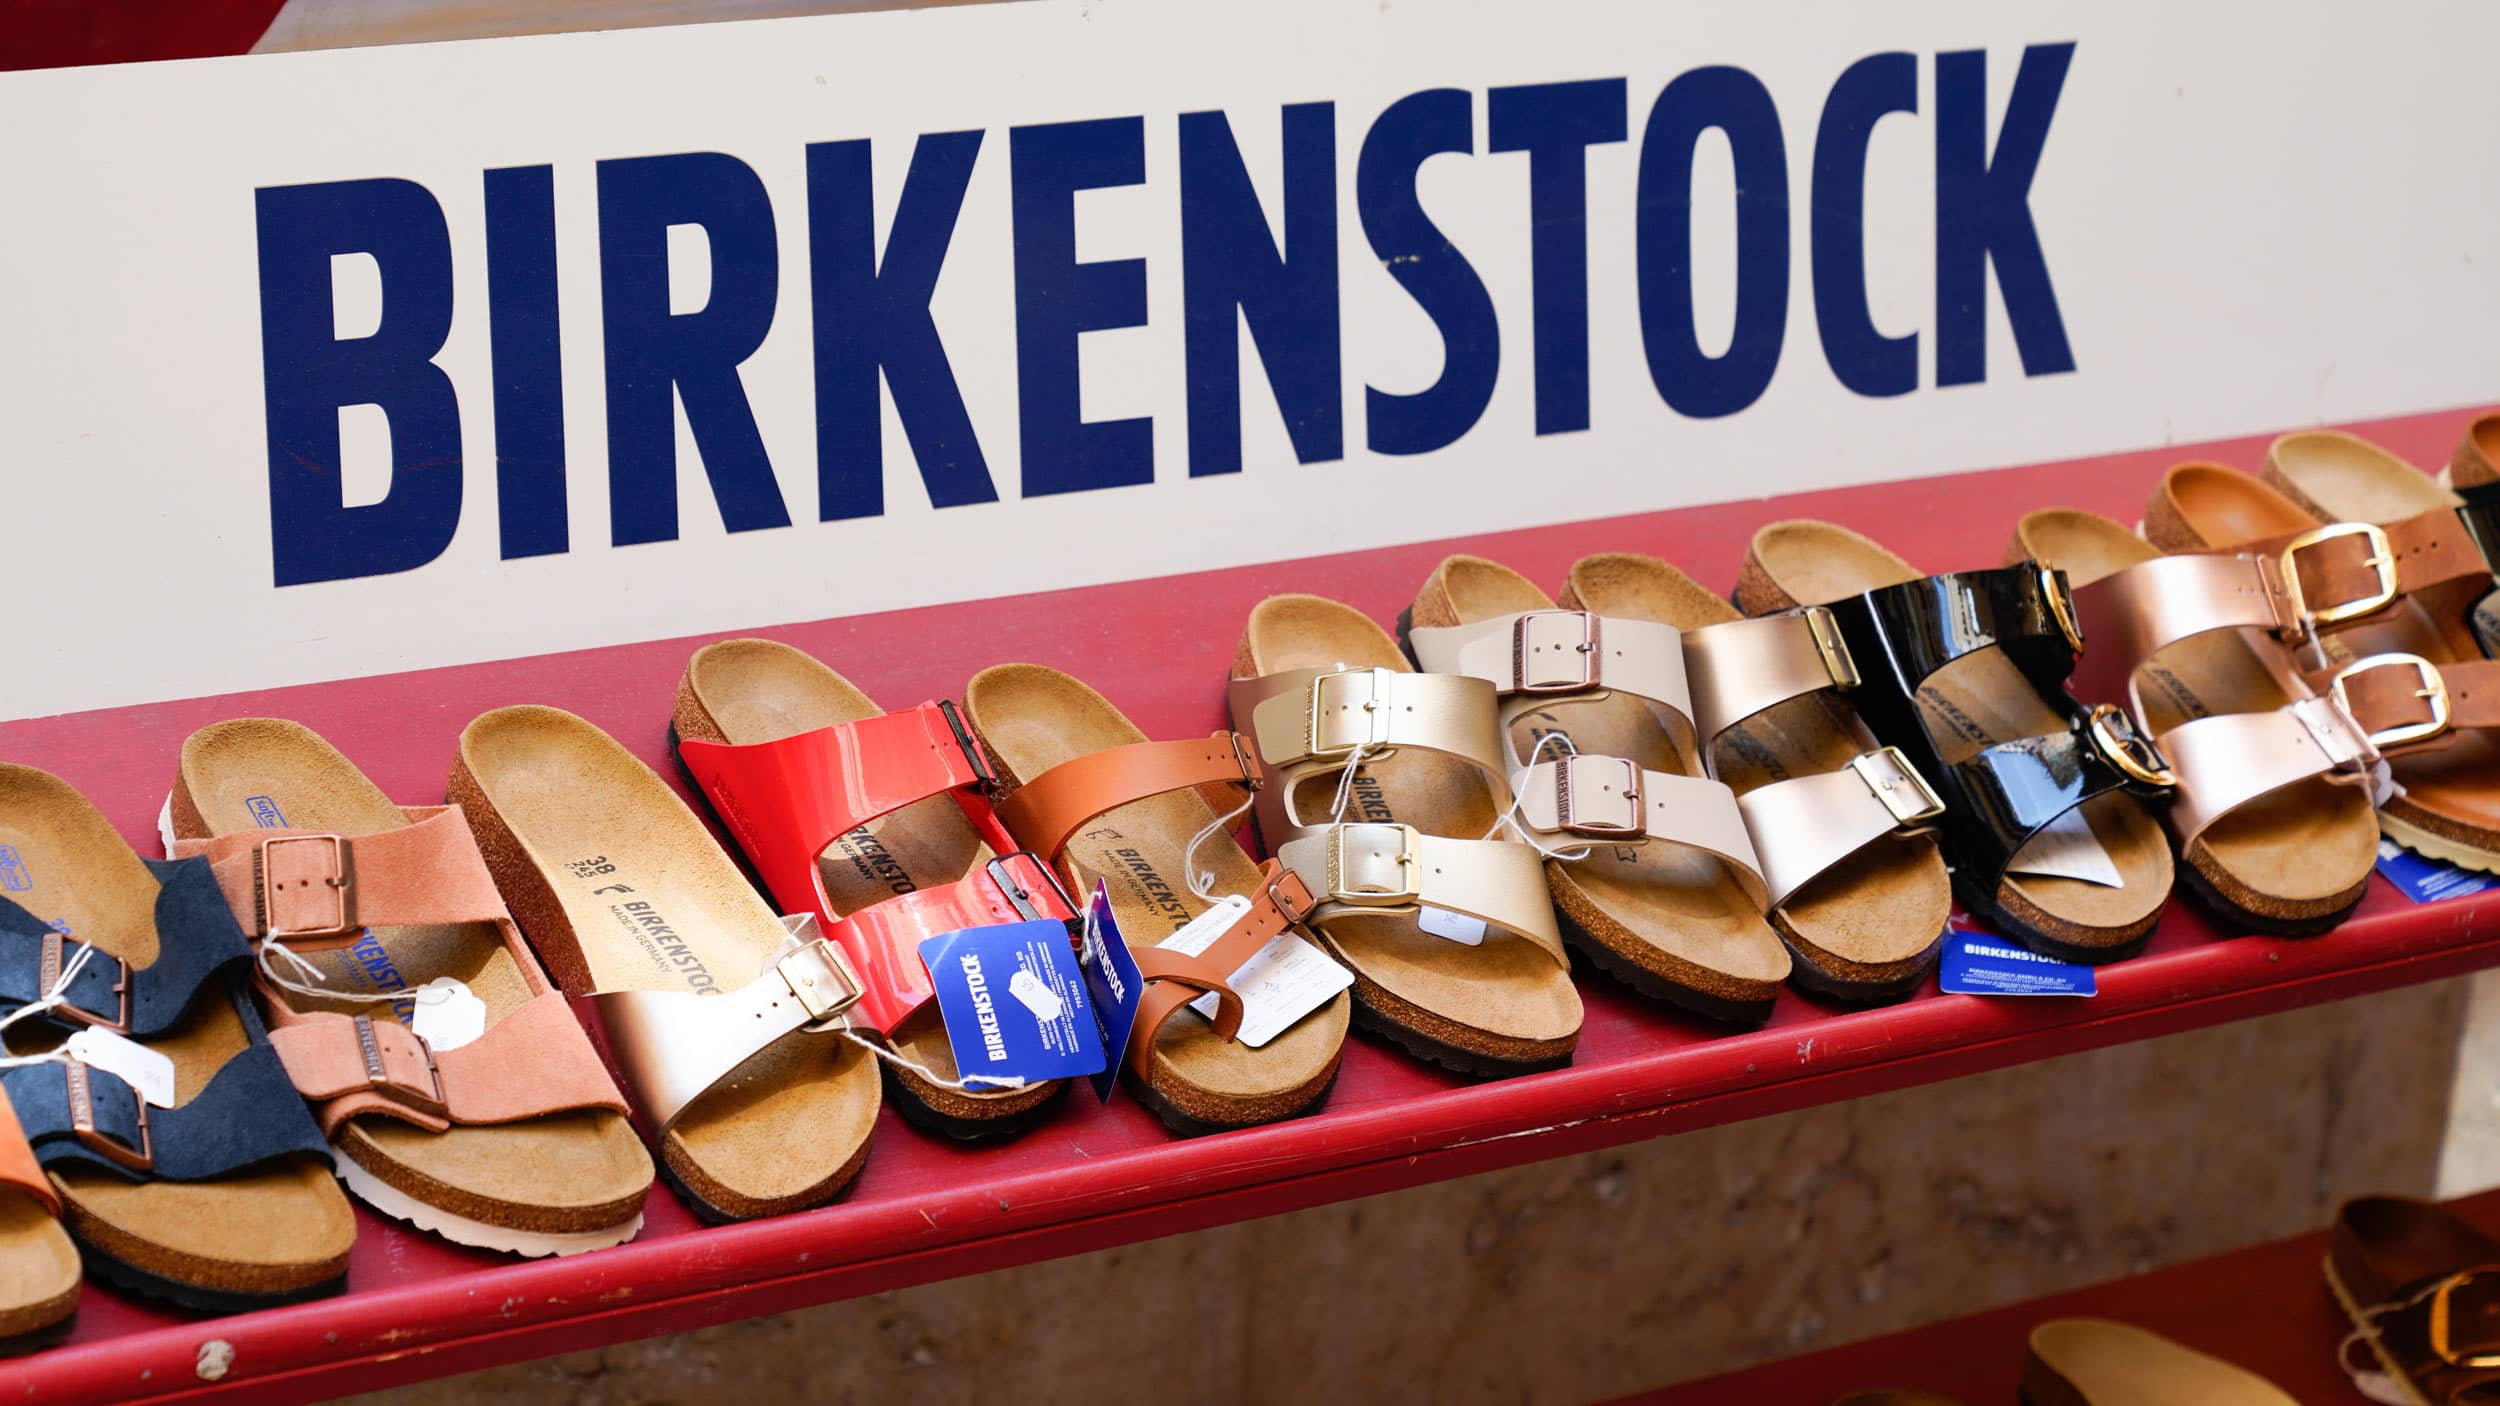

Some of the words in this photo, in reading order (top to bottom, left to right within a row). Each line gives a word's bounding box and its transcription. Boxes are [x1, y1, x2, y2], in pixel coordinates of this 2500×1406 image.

[255, 42, 2077, 587] BIRKENSTOCK
[572, 861, 597, 878] 245
[586, 855, 616, 875] 38
[1127, 878, 1161, 918] GERMANY
[608, 904, 632, 926] MADE
[635, 933, 673, 974] GERMANY
[623, 900, 723, 997] BIRKENSTOC
[960, 953, 1008, 1062] BIRKENSTOCK
